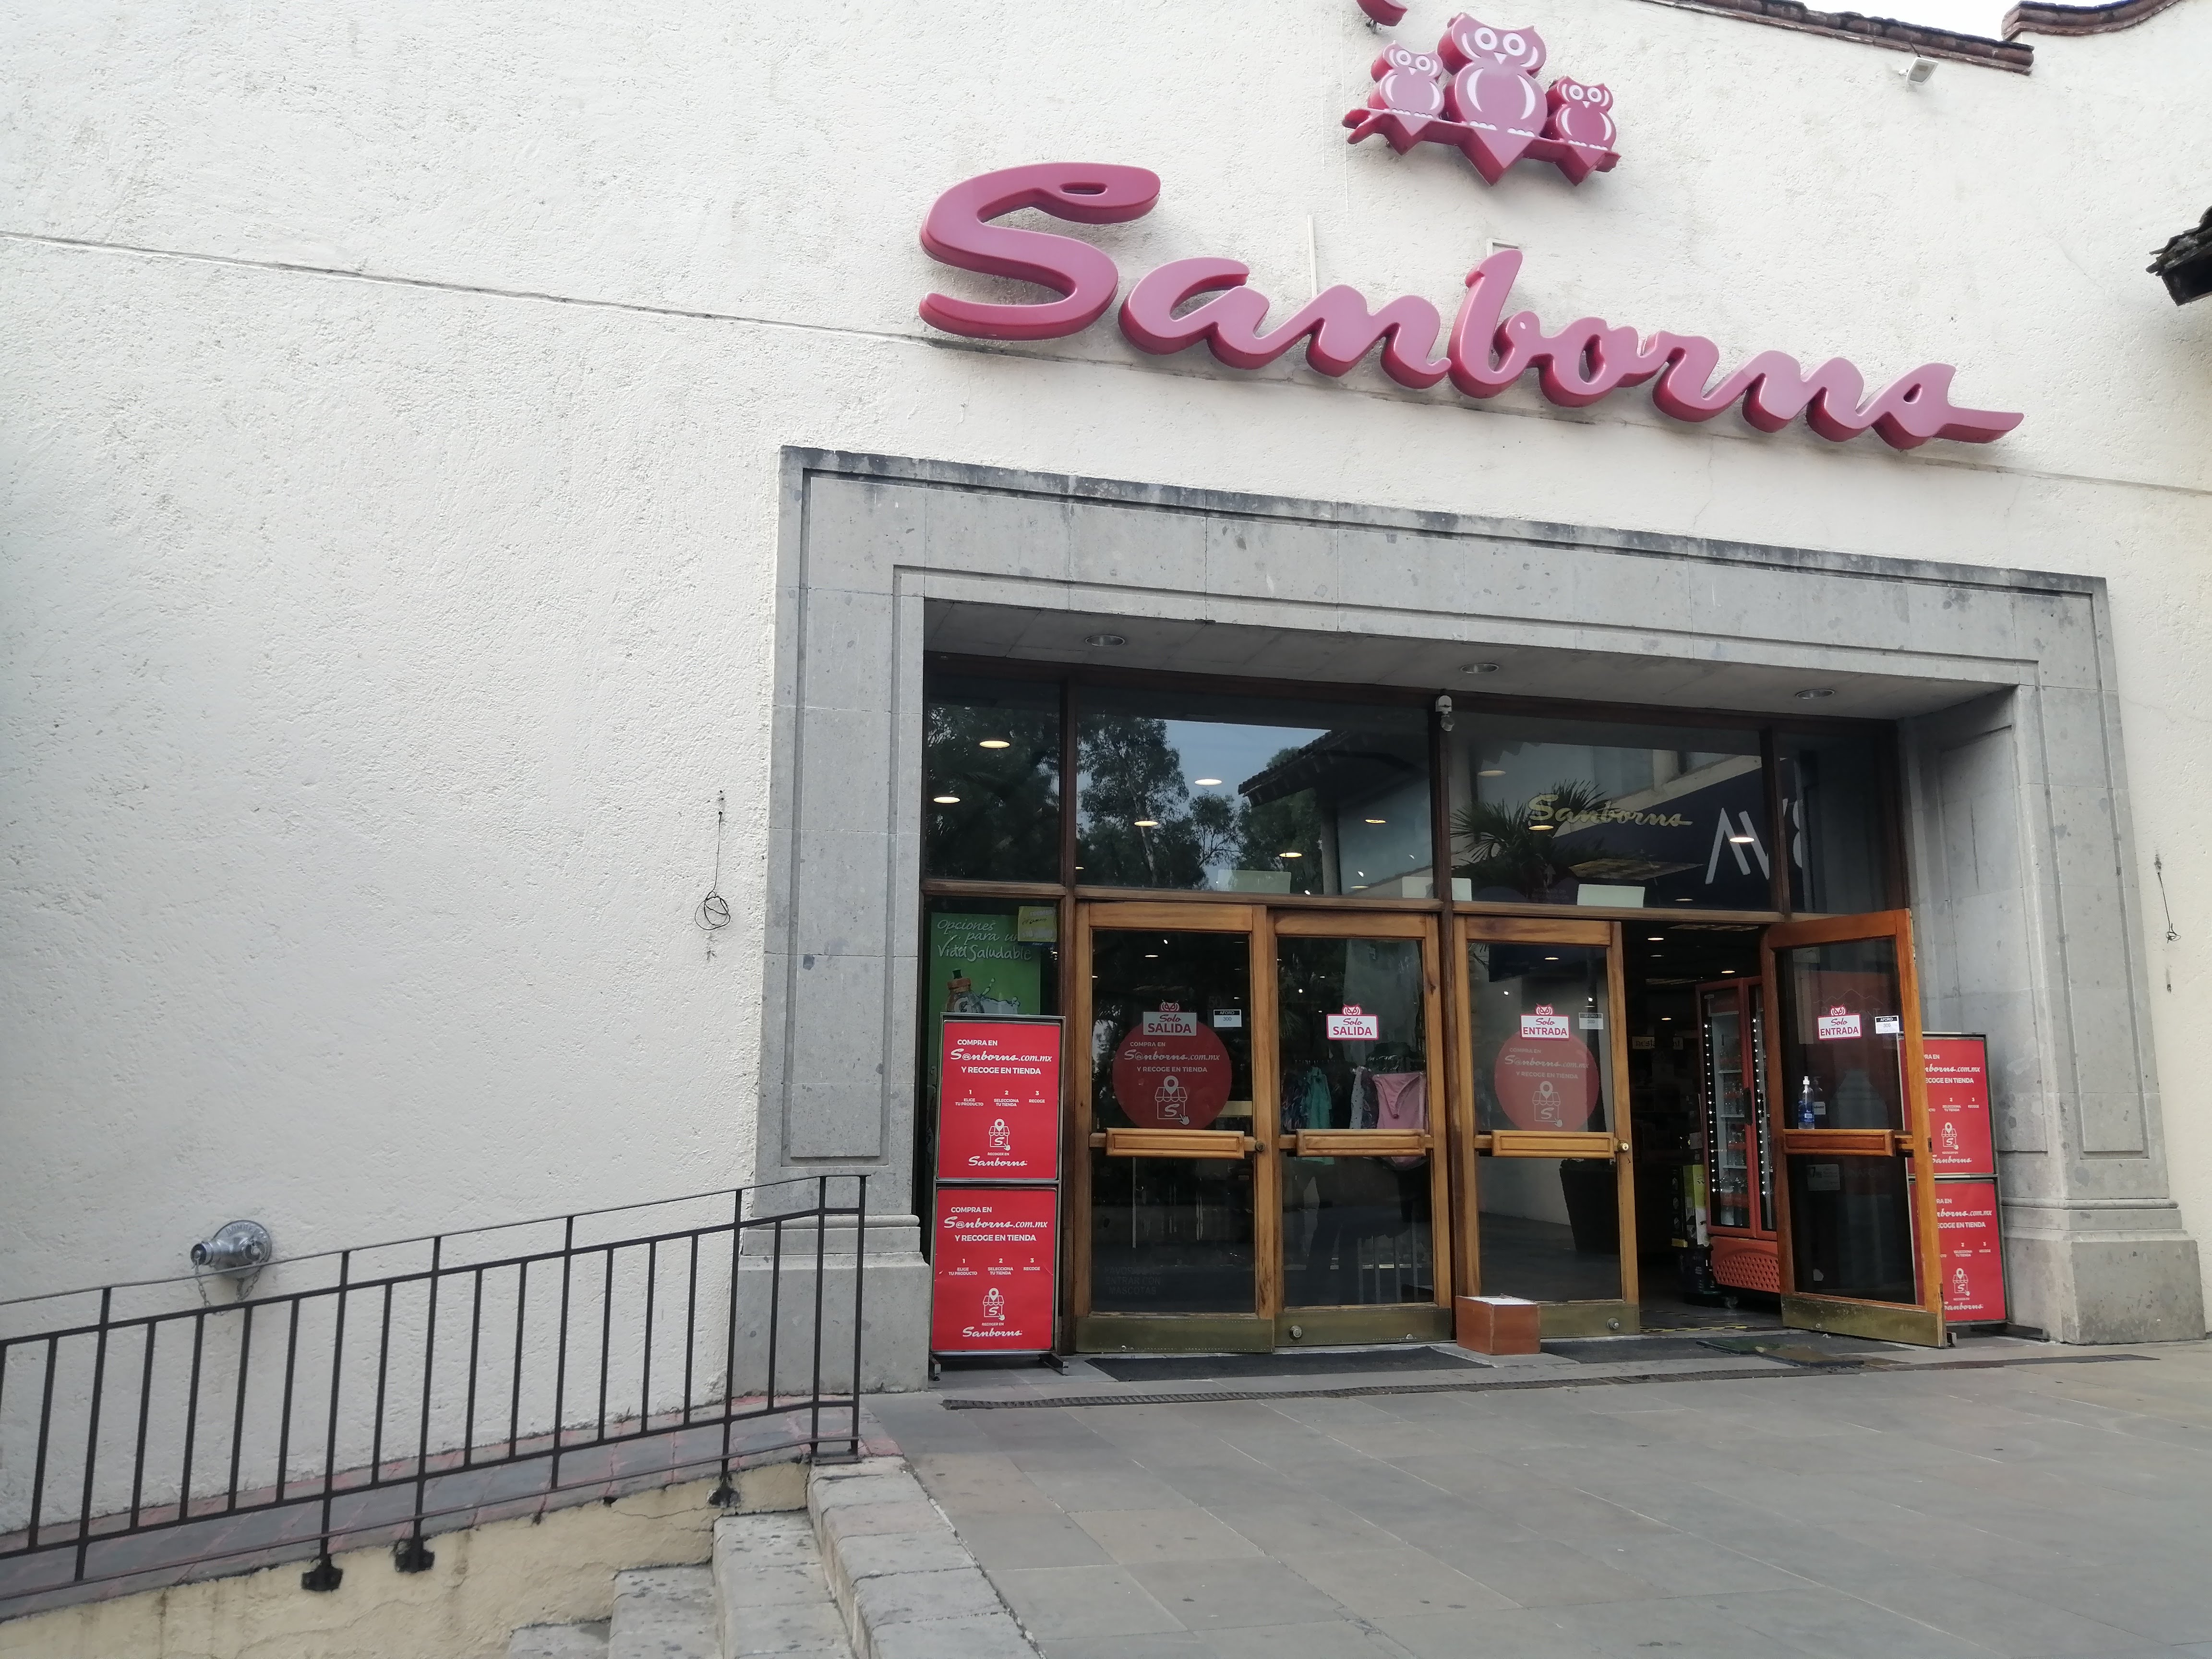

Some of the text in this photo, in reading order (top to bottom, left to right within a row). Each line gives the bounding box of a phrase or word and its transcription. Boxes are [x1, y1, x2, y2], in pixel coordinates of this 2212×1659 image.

[918, 162, 2025, 450] Sanborns
[1528, 793, 1693, 827] Sanborns
[937, 919, 996, 935] Opciones
[964, 931, 1018, 946] para un
[938, 935, 1032, 962] Vida Saludable
[1159, 1014, 1182, 1022] Solo
[1343, 1018, 1363, 1026] Solo
[1536, 1018, 1555, 1026] Solo
[1830, 1018, 1848, 1026] Solo
[1148, 1023, 1192, 1034] SALIDA
[1333, 1026, 1372, 1035] SALIDA
[1523, 1027, 1567, 1035] ENTRADA
[1820, 1026, 1859, 1036] ENTRADA
[950, 1048, 1052, 1062] S@nborns.com.mx
[1124, 1049, 1220, 1060] S@nborns.com.mx
[1924, 1063, 1981, 1072] nborns.com.mx
[968, 1155, 1028, 1166] Sanborns
[944, 1216, 1048, 1228] S@nborns.com.mx
[962, 1326, 1022, 1337] Sanborns
